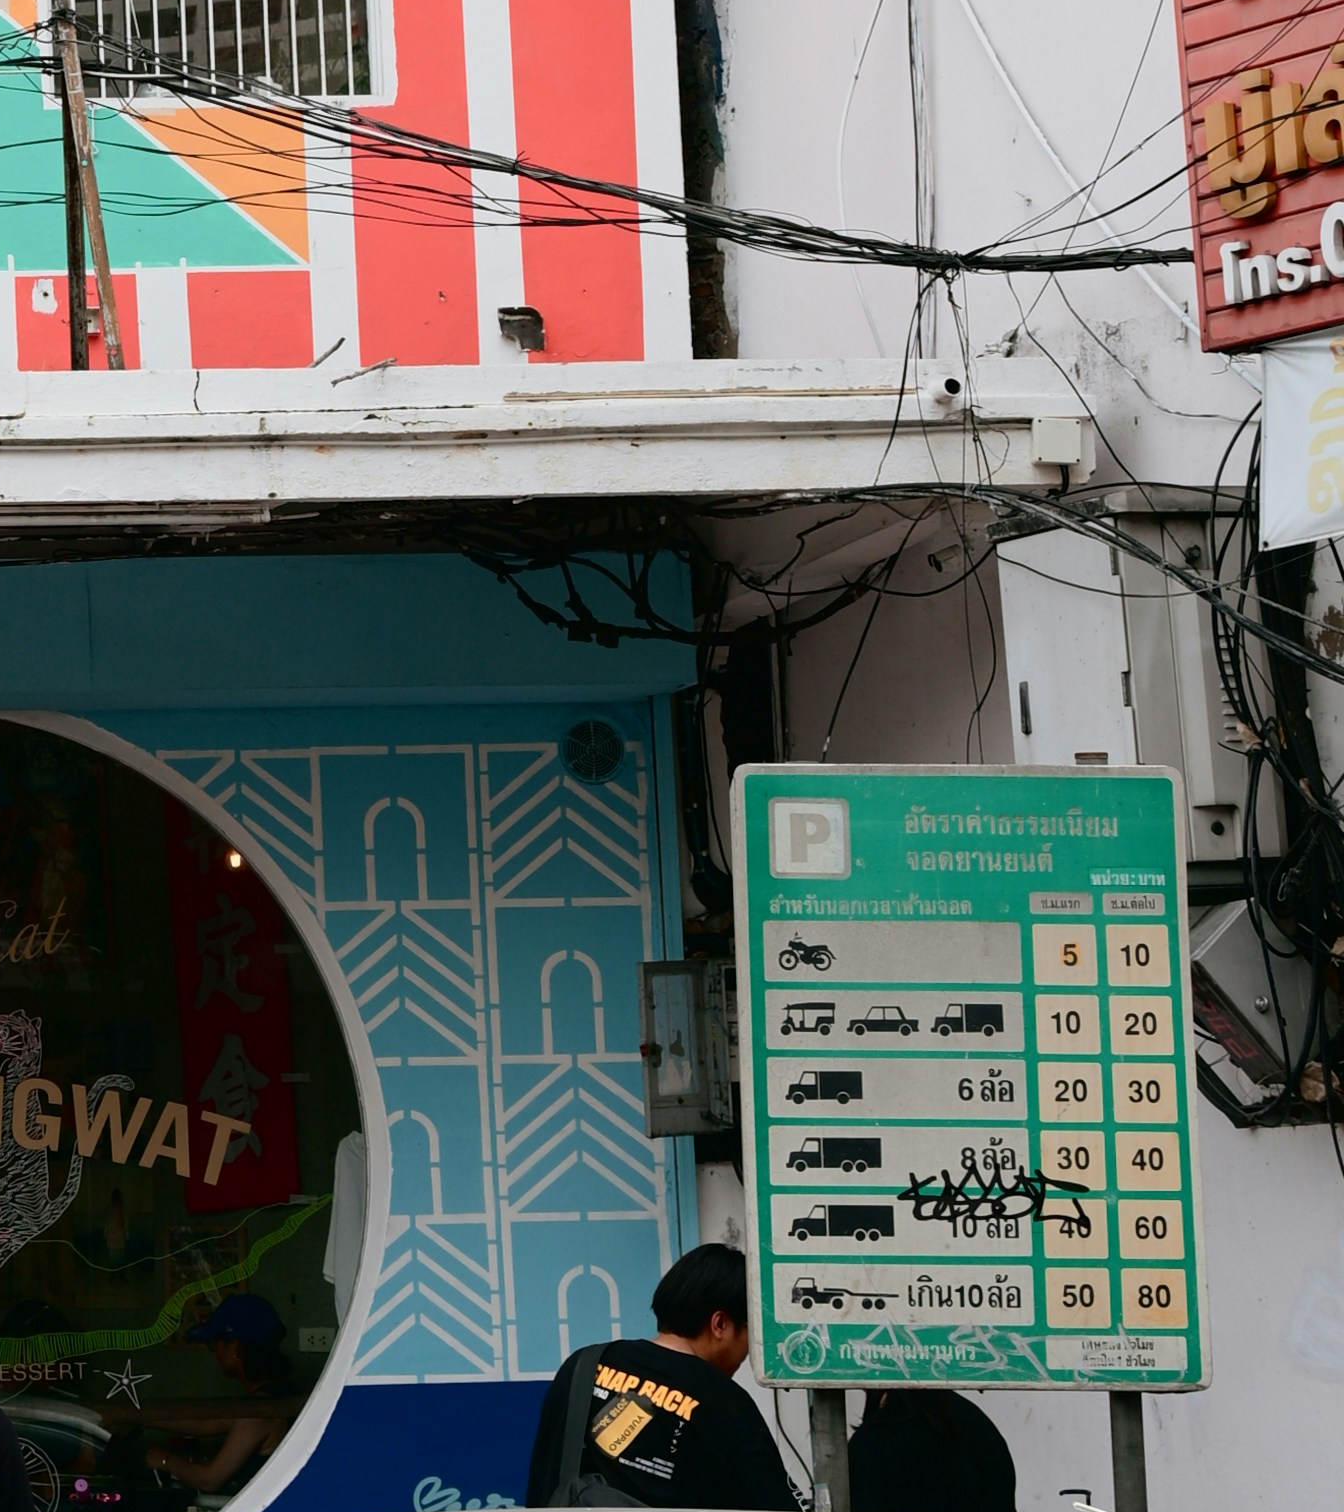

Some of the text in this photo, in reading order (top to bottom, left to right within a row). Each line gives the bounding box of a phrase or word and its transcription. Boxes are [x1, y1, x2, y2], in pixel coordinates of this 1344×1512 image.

[904, 804, 1119, 838] อัตราค่าธรรมเนียม
[789, 812, 832, 863] P
[906, 842, 1054, 873] จอดยานยนต์
[1062, 943, 1150, 967] 5 10
[1050, 1011, 1158, 1038] 10 20
[1053, 1078, 1088, 1103] 20
[1127, 1079, 1161, 1104] 30
[1056, 1146, 1090, 1170] 30
[1130, 1146, 1164, 1171] 40
[1133, 1215, 1167, 1240] 60
[1061, 1284, 1095, 1307] 50
[1137, 1284, 1171, 1309] 80
[595, 1364, 641, 1395] NAP
[638, 1379, 700, 1422] BACK
